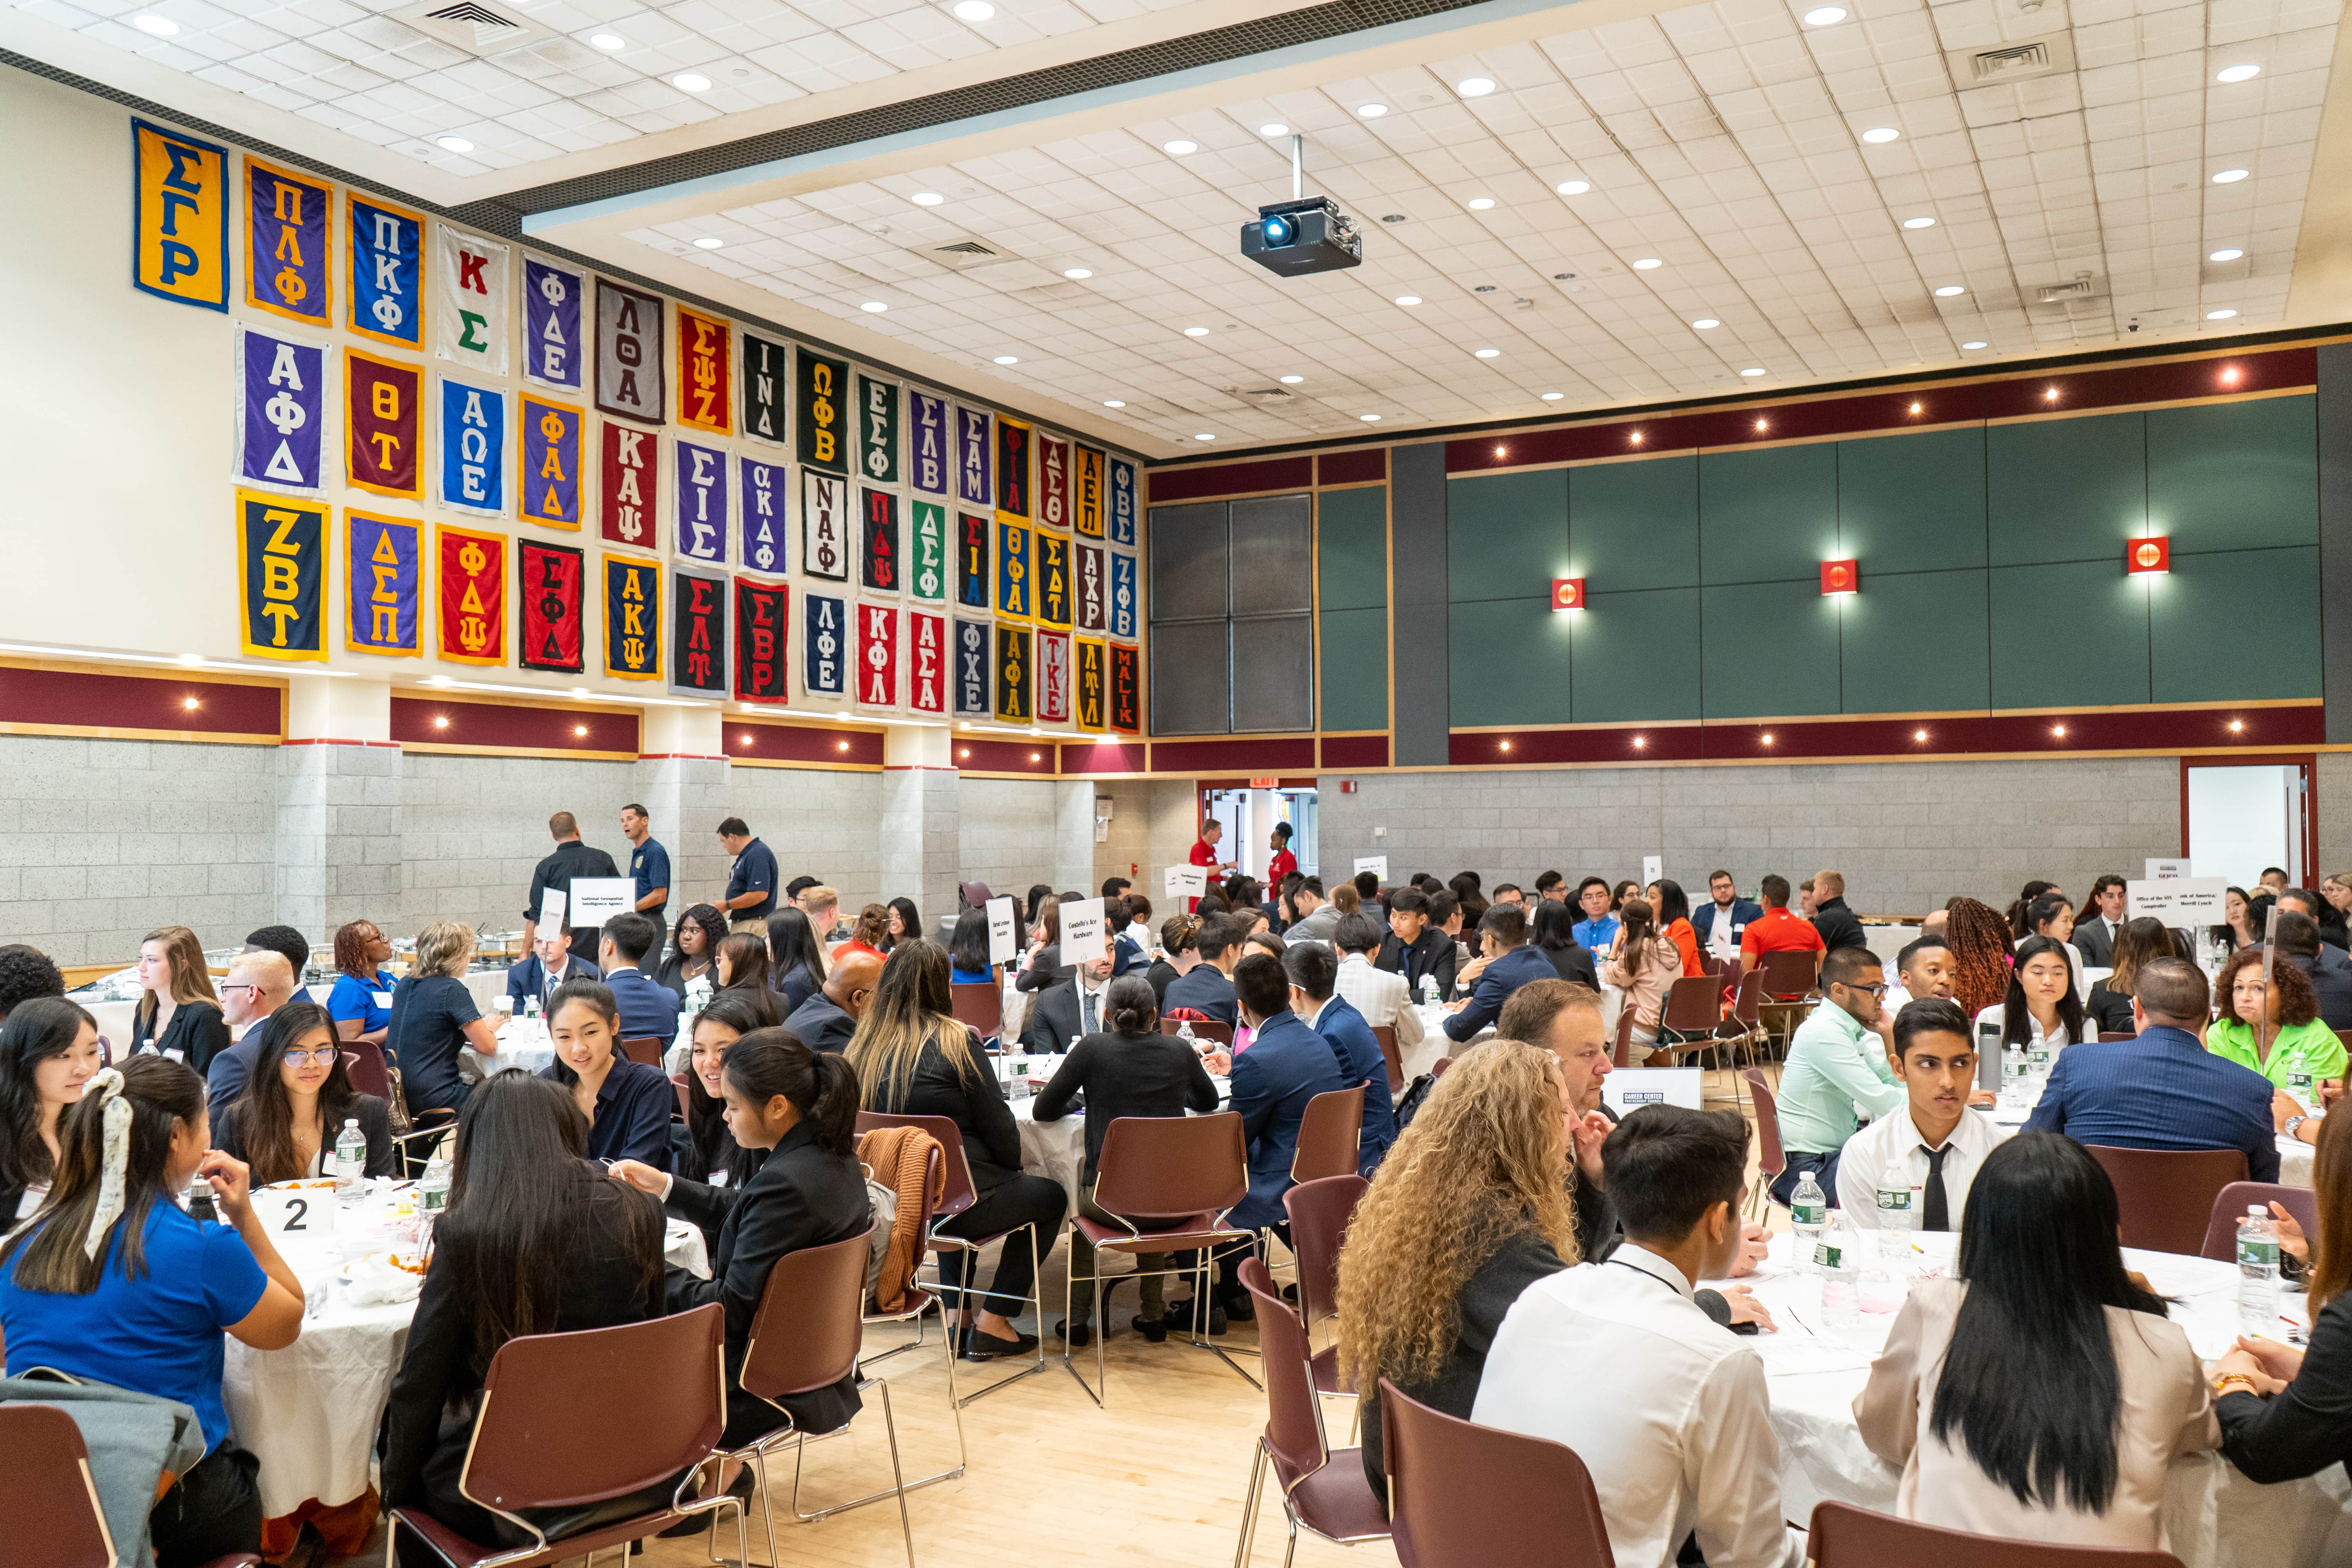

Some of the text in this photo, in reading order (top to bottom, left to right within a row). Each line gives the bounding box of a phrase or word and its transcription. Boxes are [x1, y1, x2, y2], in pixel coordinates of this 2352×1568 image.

[1118, 651, 1133, 723] MALIK
[1069, 920, 1089, 929] Costello's
[1073, 931, 1093, 939] Hardware
[283, 1199, 307, 1231] 2
